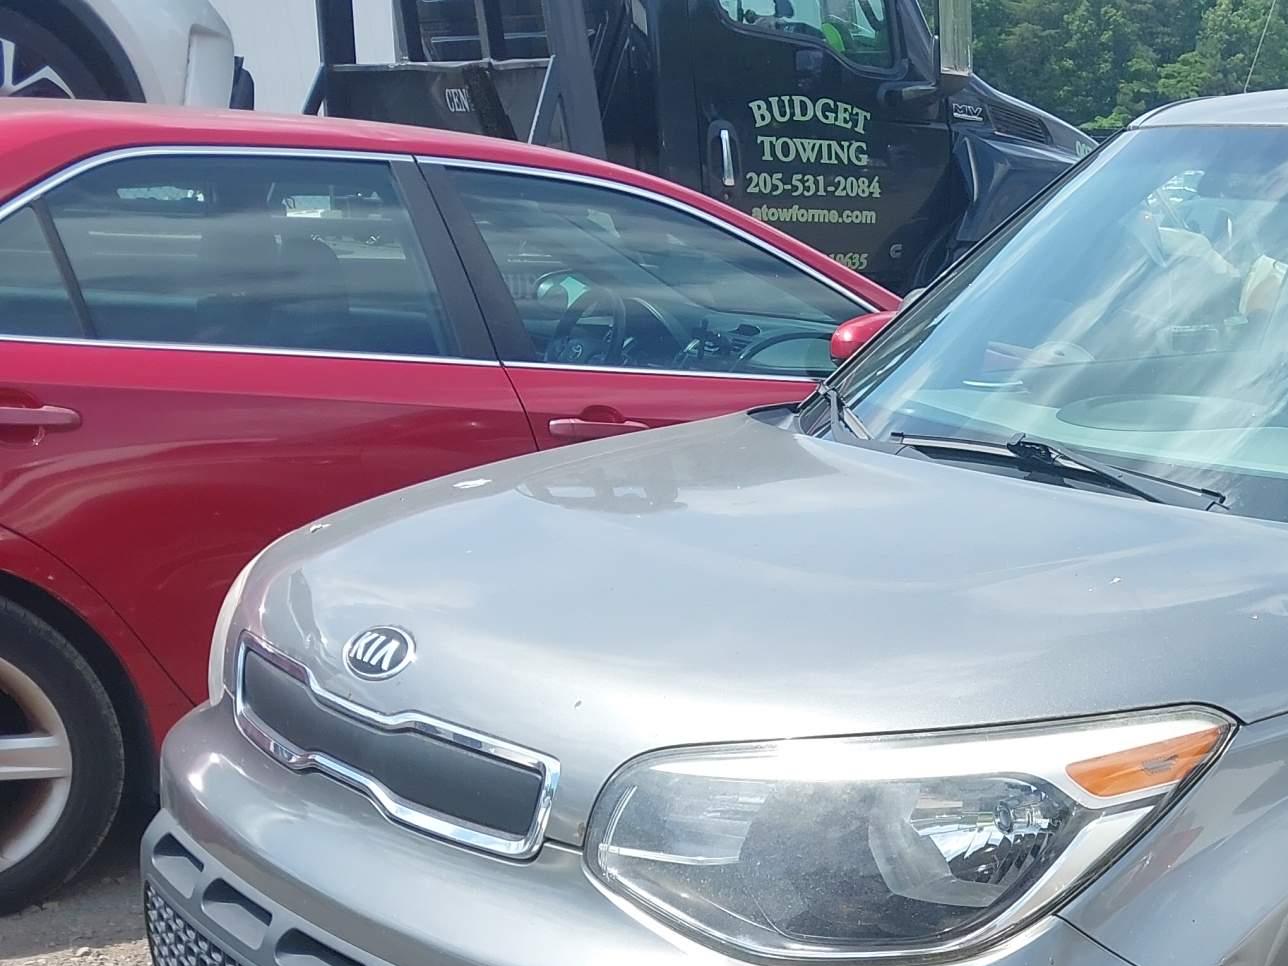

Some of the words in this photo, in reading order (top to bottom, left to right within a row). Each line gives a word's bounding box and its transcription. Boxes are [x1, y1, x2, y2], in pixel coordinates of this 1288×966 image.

[445, 87, 475, 112] CEN
[952, 103, 982, 117] MV
[748, 95, 871, 134] BUDGET
[757, 135, 869, 166] TOWING
[746, 171, 881, 198] 205-531-2084
[751, 204, 876, 224] atowforme.com
[349, 631, 400, 671] KIA
